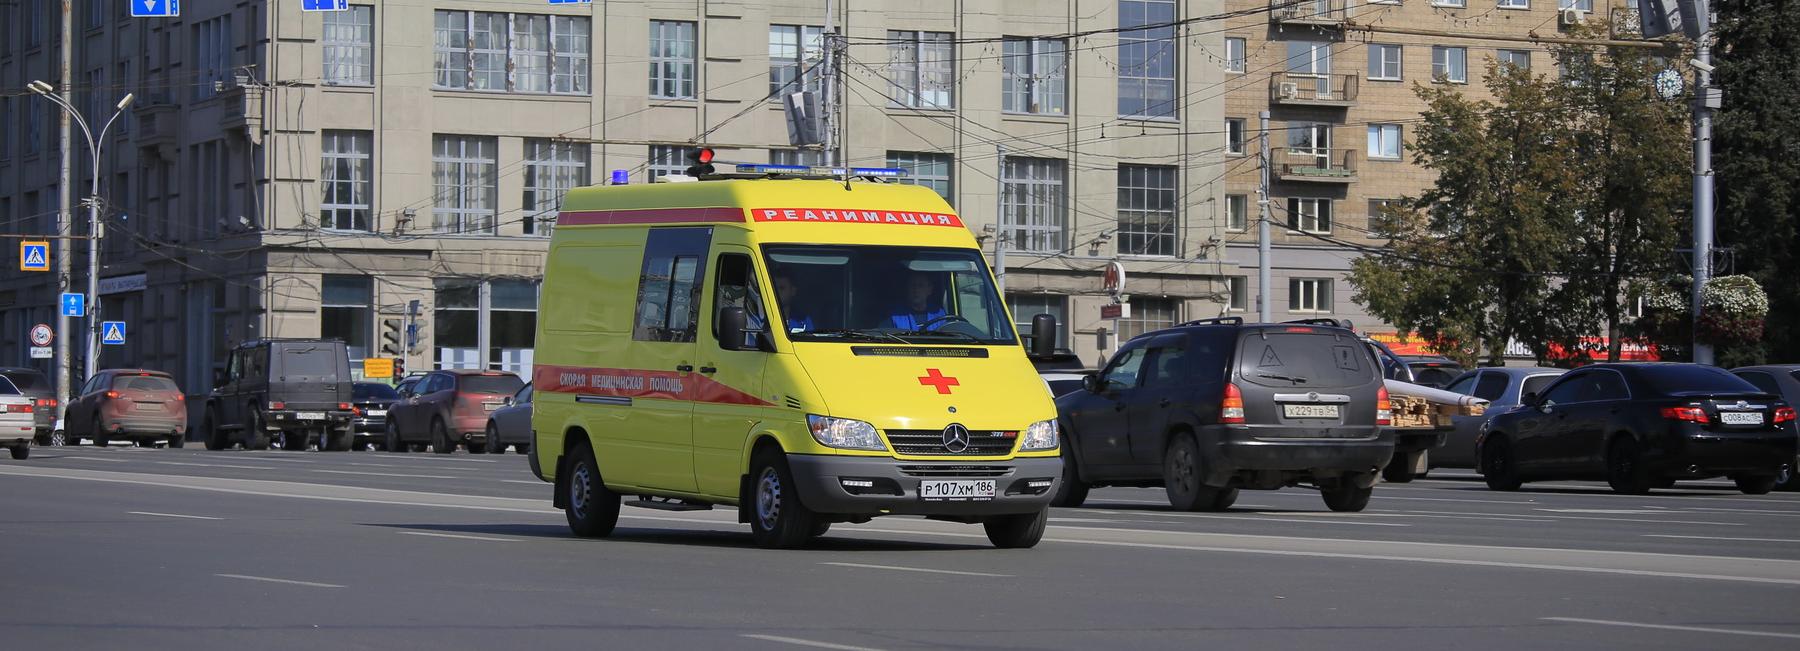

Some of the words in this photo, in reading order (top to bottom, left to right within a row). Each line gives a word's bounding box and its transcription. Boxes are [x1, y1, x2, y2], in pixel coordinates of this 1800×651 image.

[763, 209, 951, 225] РЕАНИМАЦИЯ
[560, 374, 586, 387] СКОРАЯ
[591, 374, 643, 391] МЕДИЦИНСКАЯ
[650, 377, 682, 393] ПОМОЩЬ
[925, 483, 973, 495] Р107ХМ
[976, 481, 992, 492] 186
